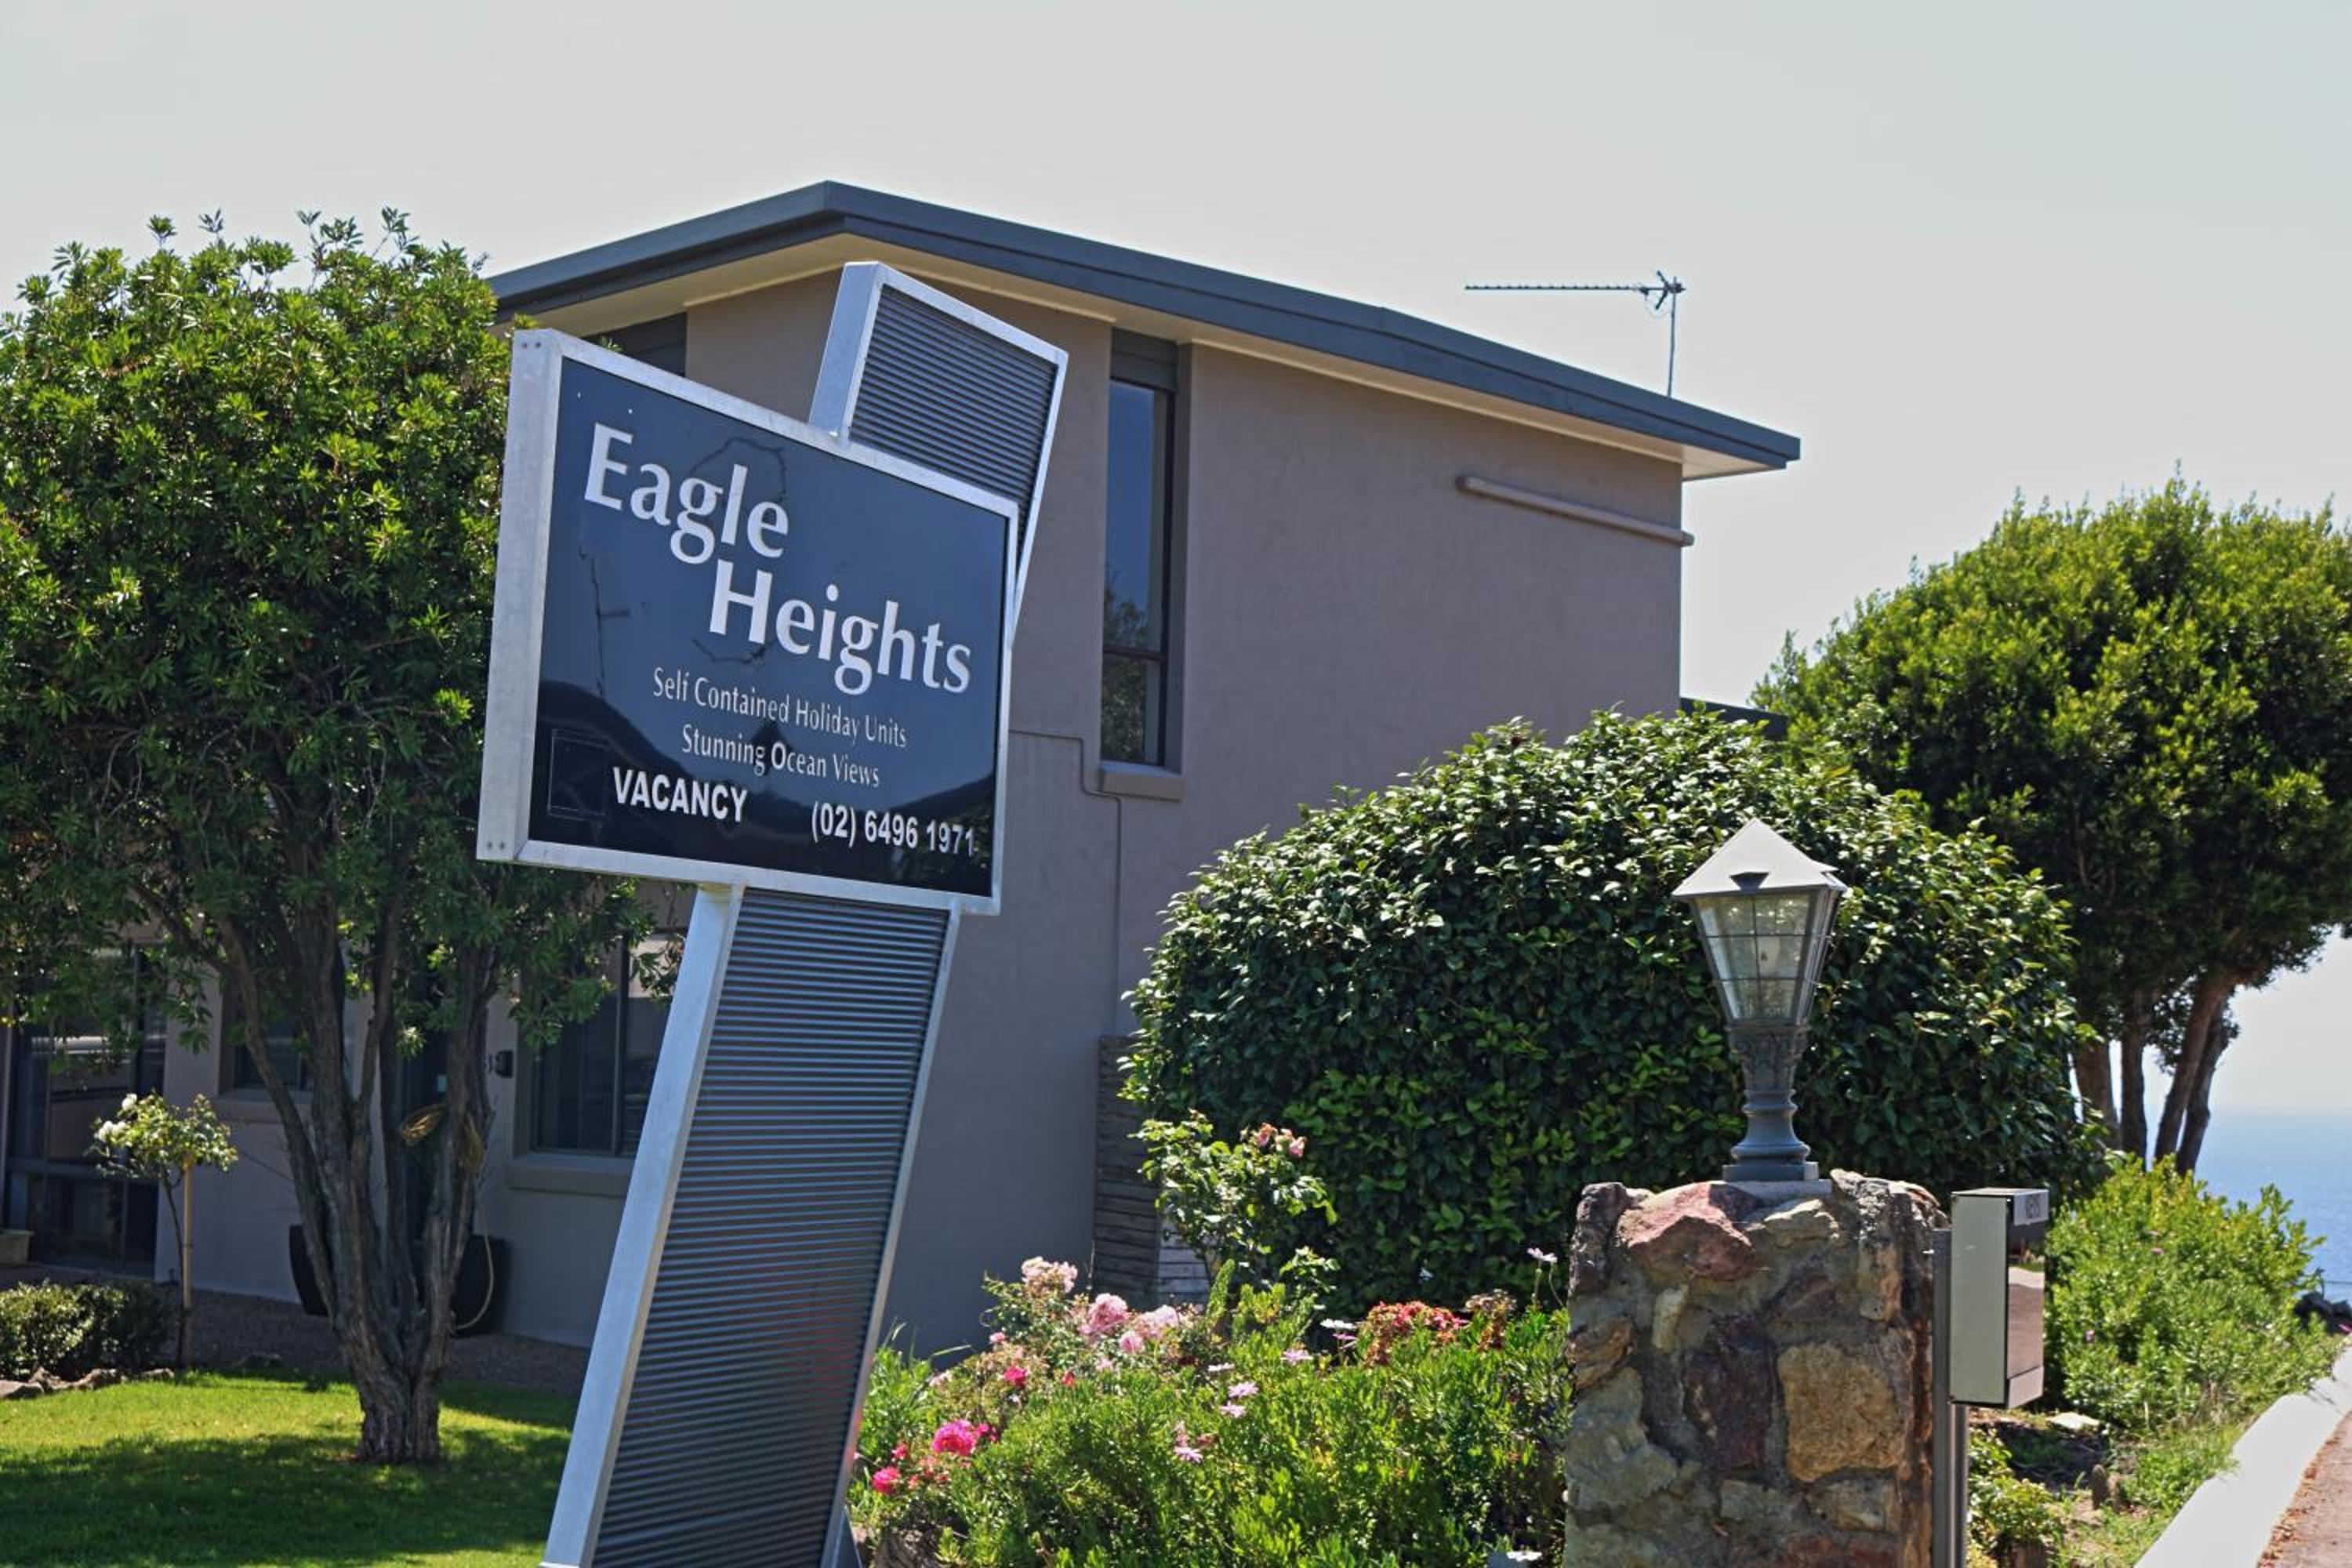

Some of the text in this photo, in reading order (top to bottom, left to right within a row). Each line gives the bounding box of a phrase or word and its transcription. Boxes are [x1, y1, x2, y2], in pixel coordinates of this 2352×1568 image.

[584, 423, 789, 564] Eagle
[708, 560, 971, 695] Heights
[695, 677, 789, 724] Contained
[796, 698, 860, 746] Holiday
[865, 714, 906, 747] Units
[682, 724, 880, 788] Stunning Ocean Views
[612, 766, 747, 822] VACANCY
[811, 800, 975, 857] (02) 6496 1971
